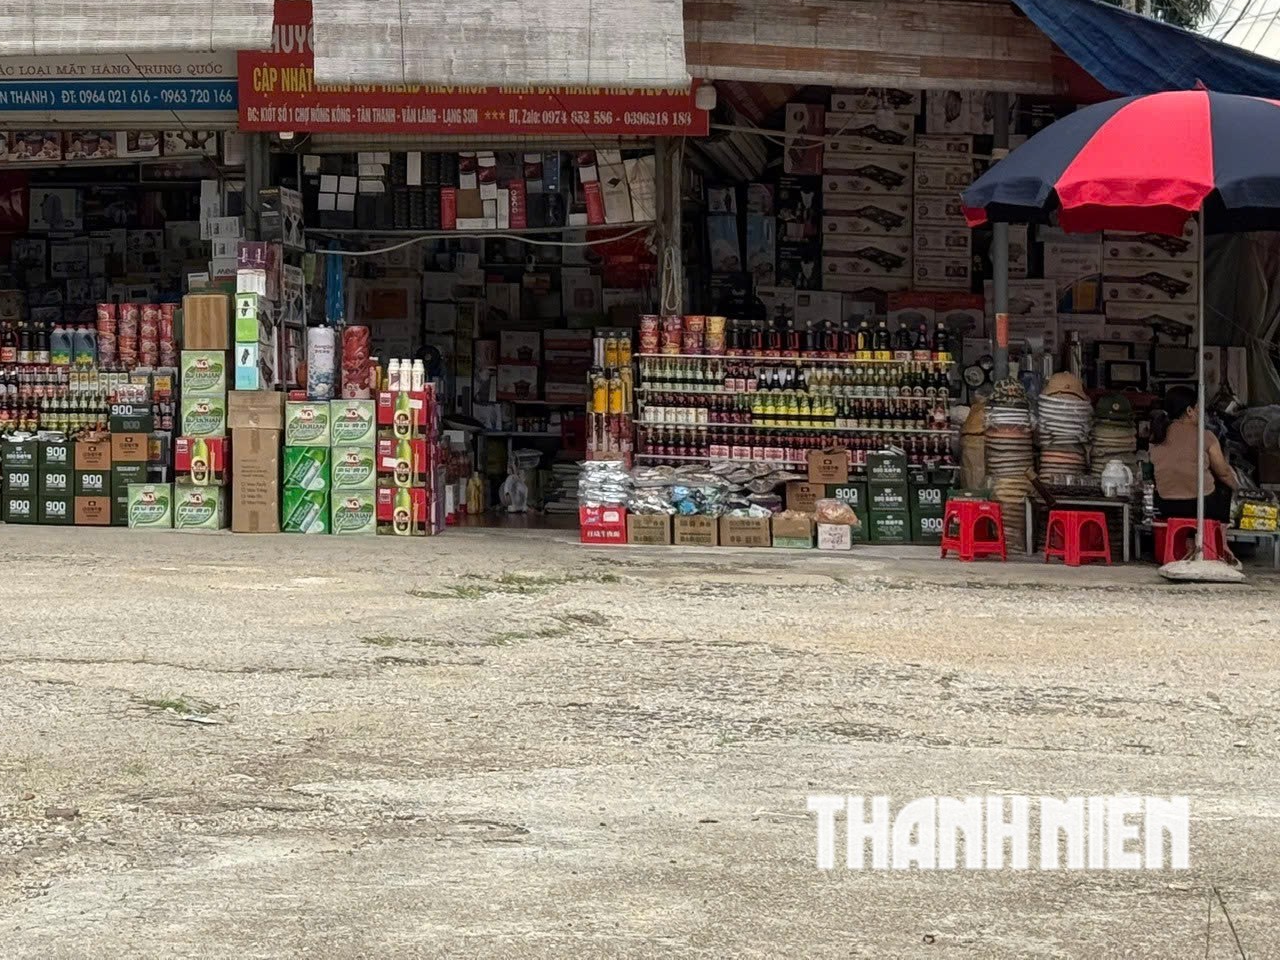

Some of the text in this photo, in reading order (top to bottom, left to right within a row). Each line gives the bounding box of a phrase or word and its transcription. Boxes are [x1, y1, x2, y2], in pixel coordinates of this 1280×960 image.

[135, 63, 182, 75] TRUNG
[186, 61, 224, 76] QUỐC
[253, 62, 278, 98] CẬP
[10, 90, 48, 104] THANH
[79, 90, 106, 104] 0964
[108, 90, 127, 104] 021
[131, 89, 151, 103] 616
[160, 89, 187, 103] 0963
[190, 89, 210, 103] 720
[213, 89, 233, 103] 166
[111, 404, 133, 415] 900
[46, 446, 67, 457] 900
[9, 473, 30, 483] 900
[46, 473, 67, 484] 900
[82, 474, 103, 484] 900
[835, 488, 858, 499] 900
[918, 489, 941, 500] 900
[9, 499, 30, 510] 900
[45, 501, 66, 511] 900
[921, 517, 943, 528] 900
